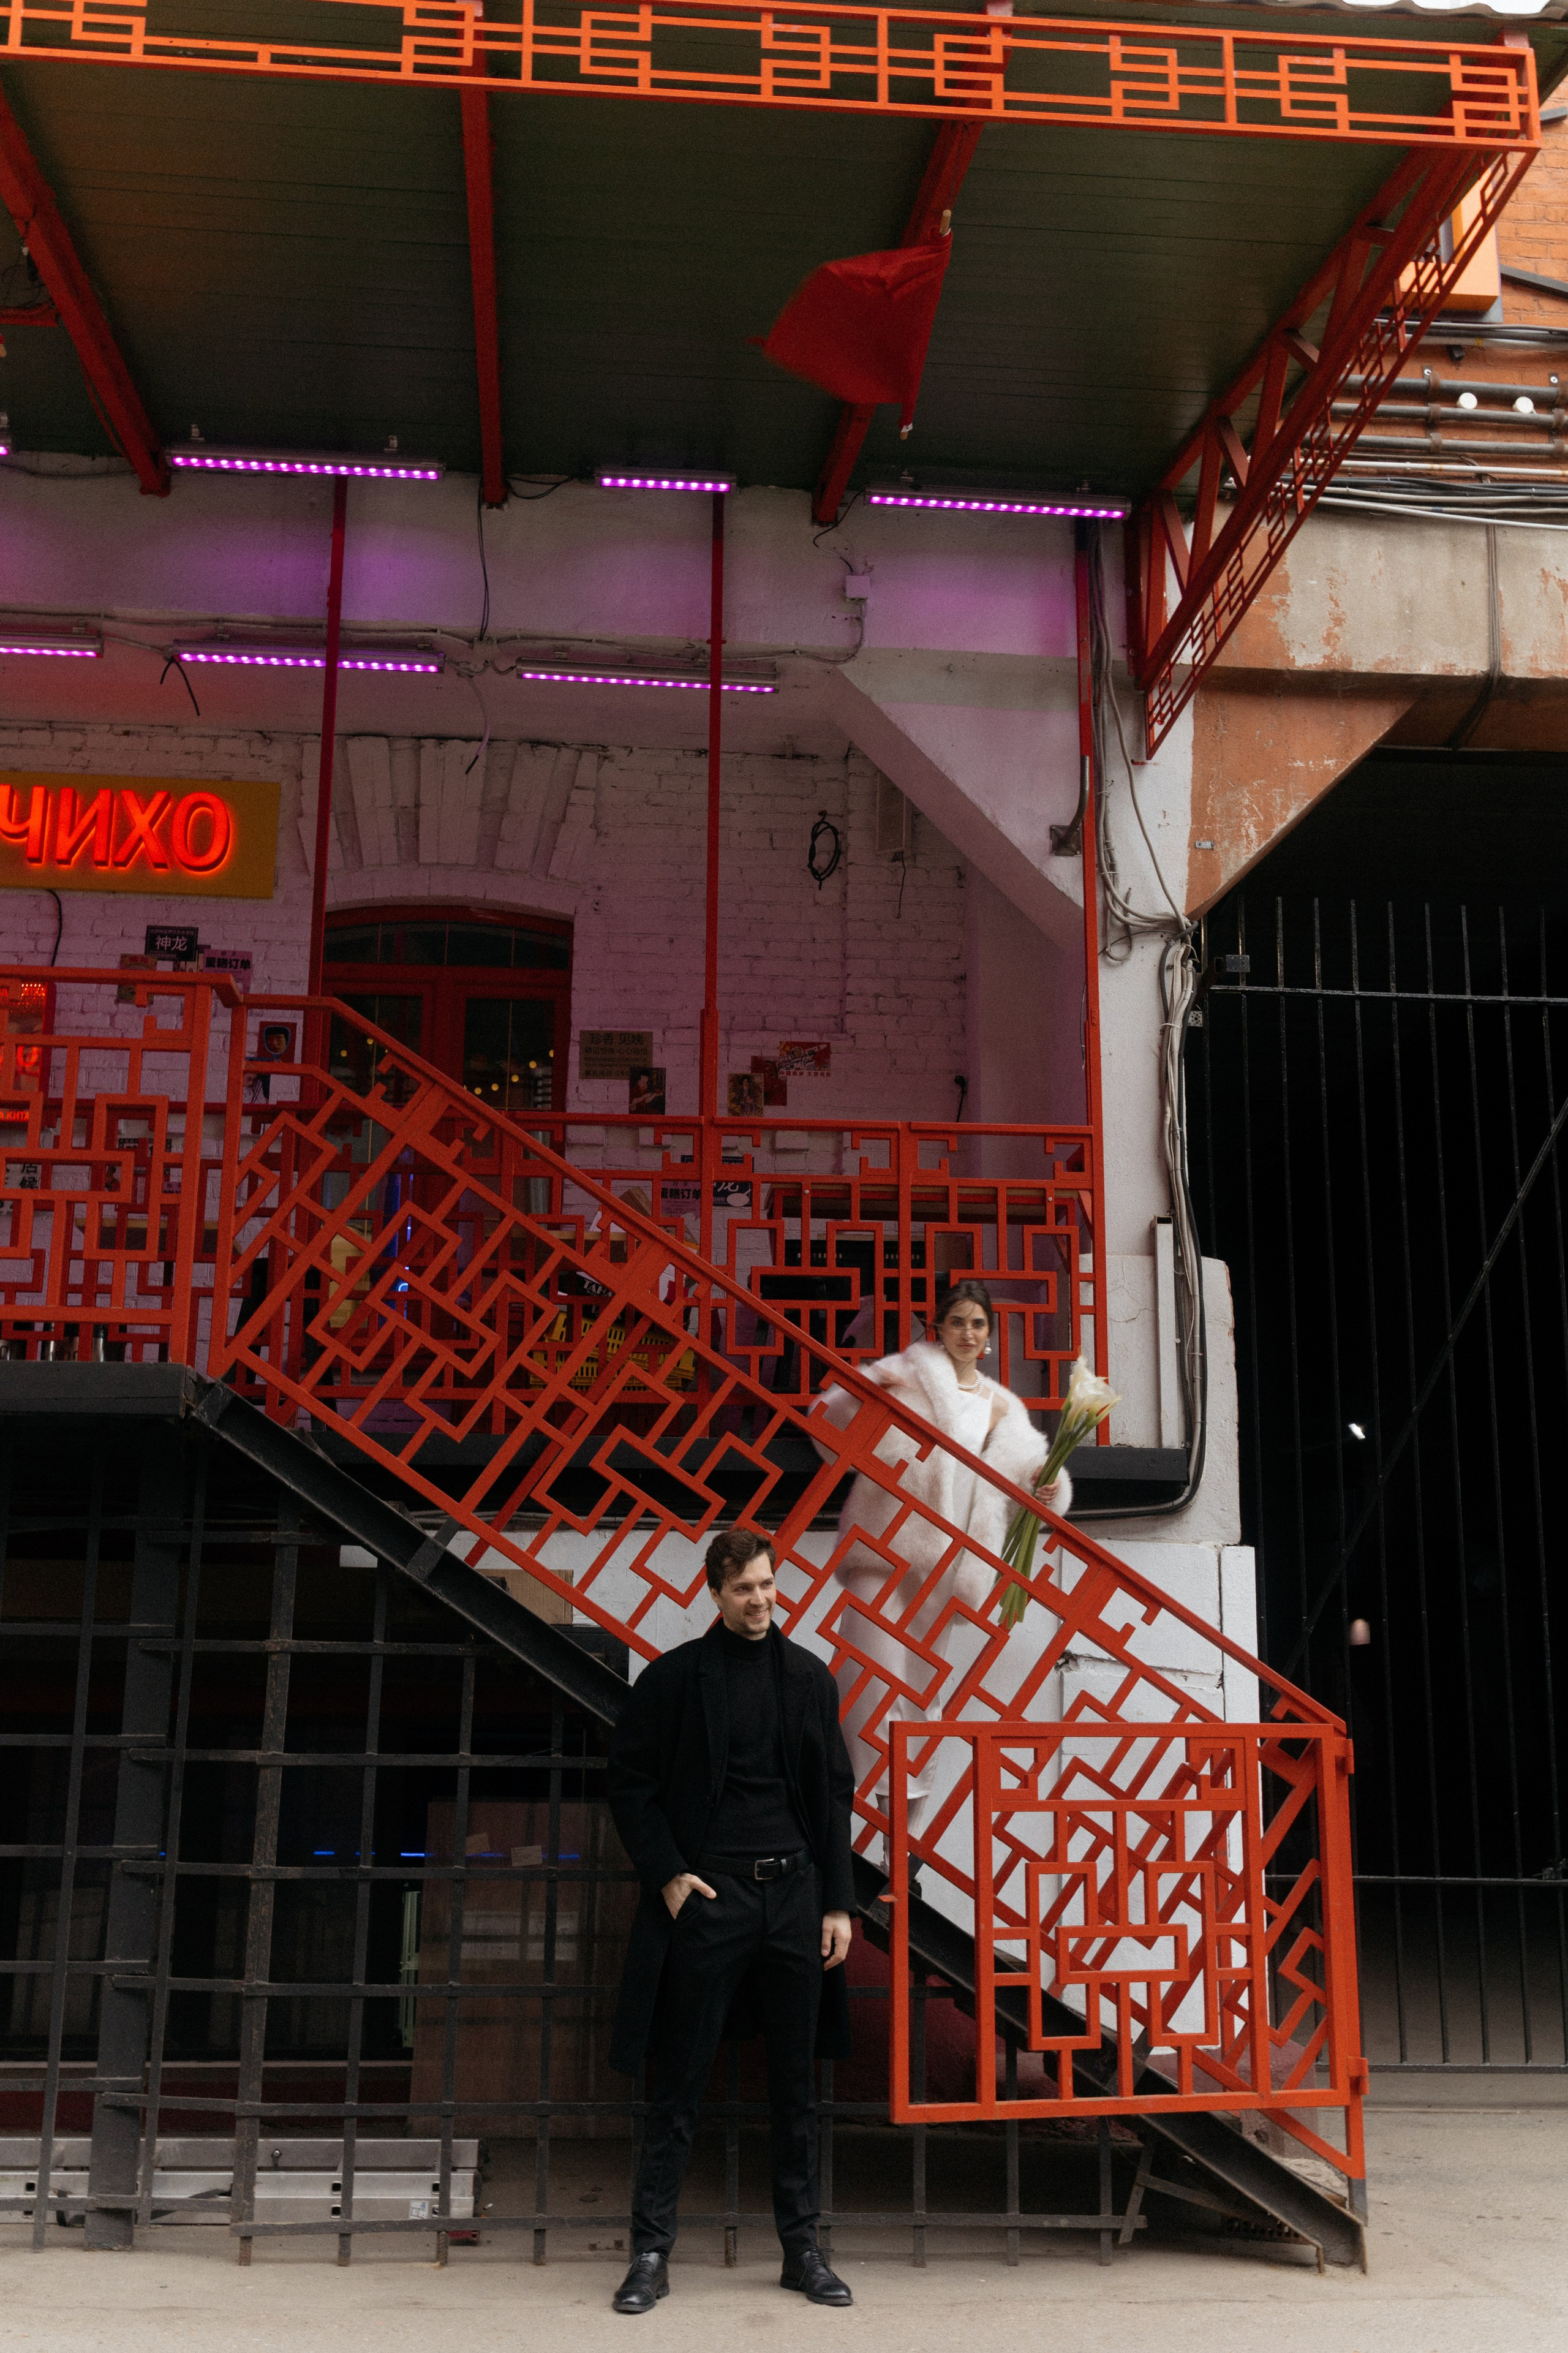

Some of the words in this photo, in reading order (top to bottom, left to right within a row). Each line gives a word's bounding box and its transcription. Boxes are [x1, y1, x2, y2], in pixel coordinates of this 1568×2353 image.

[0, 784, 231, 871] ЧИХО
[155, 935, 187, 951] 神龙
[205, 957, 251, 970] 蛋糕订单
[6, 1110, 29, 1122] КИТА
